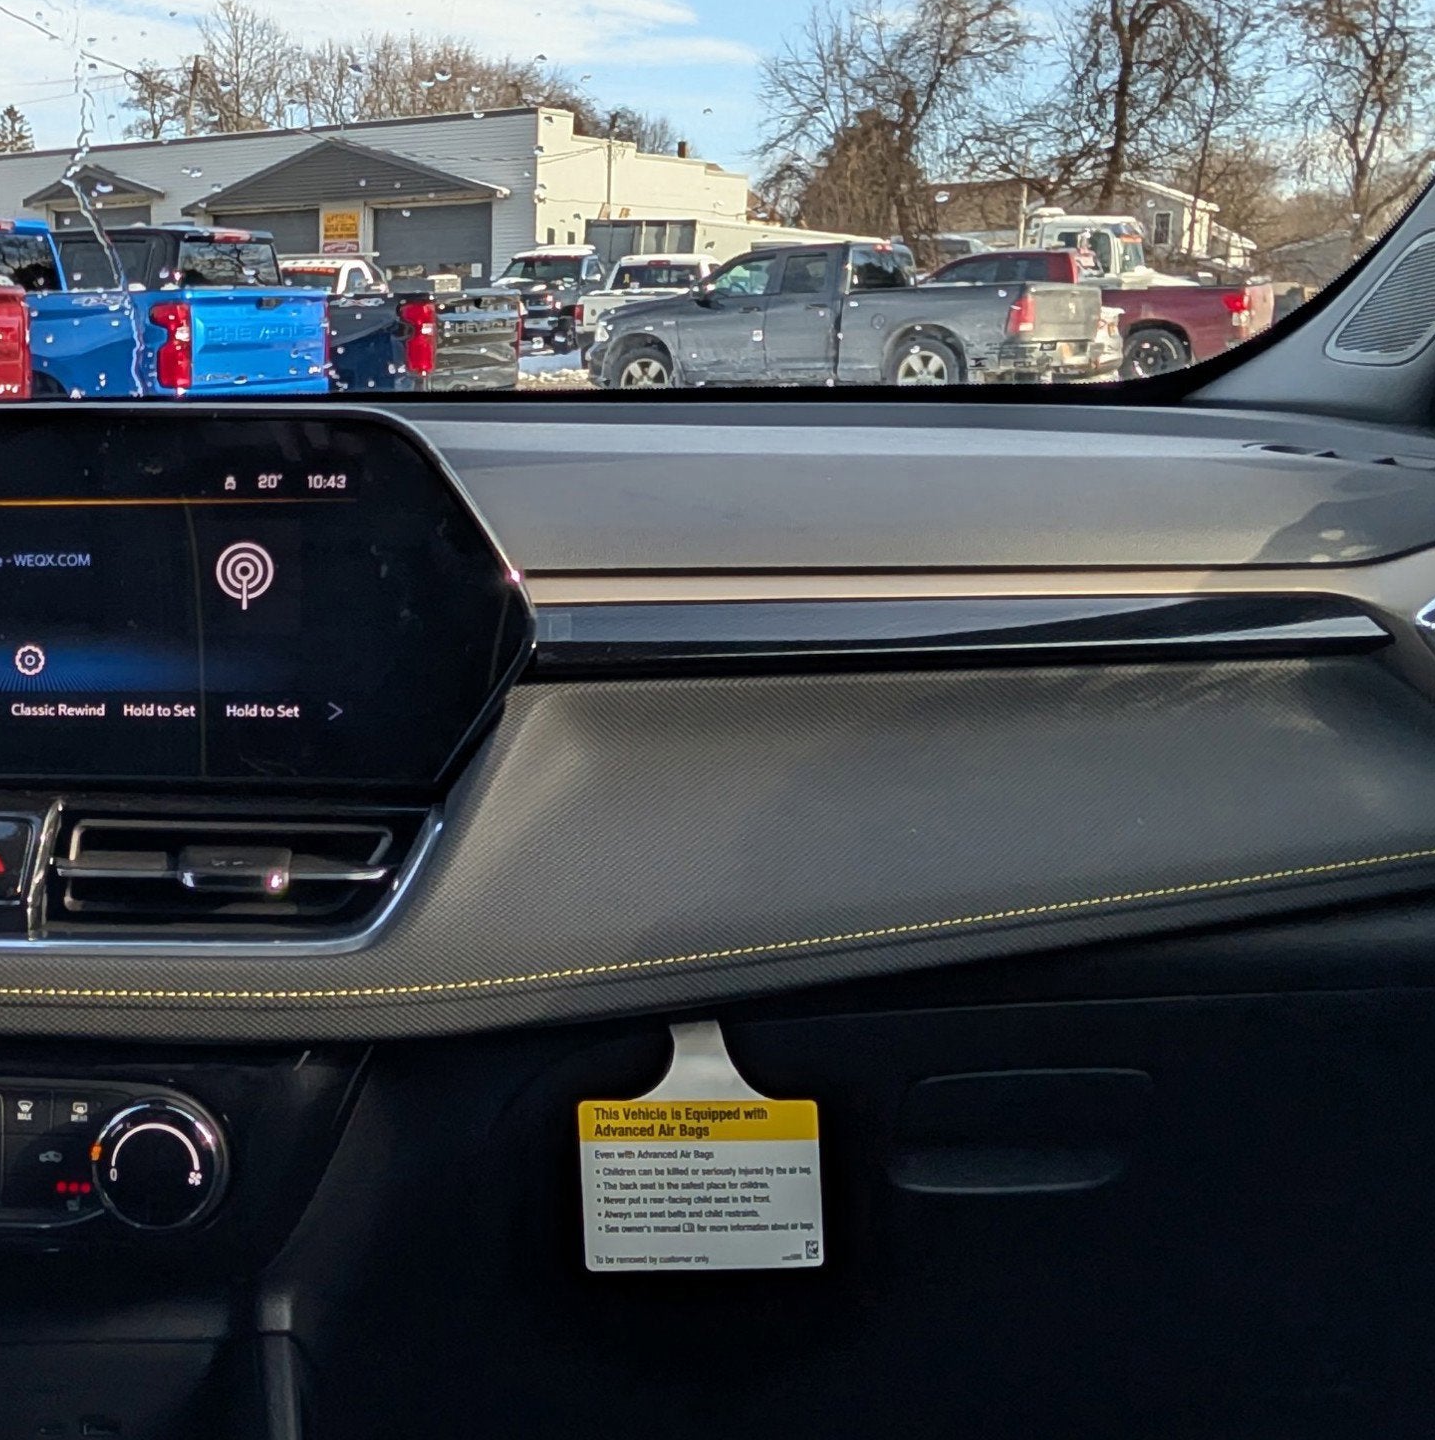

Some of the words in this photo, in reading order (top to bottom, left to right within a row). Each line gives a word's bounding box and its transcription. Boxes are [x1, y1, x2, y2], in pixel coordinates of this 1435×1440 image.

[307, 474, 347, 489] 10:43
[15, 554, 91, 567] WEQX.COM
[10, 703, 55, 716] Classic
[57, 703, 106, 717] Rewind
[123, 704, 155, 717] Hold
[157, 705, 171, 717] to
[173, 704, 196, 717] Set
[226, 704, 258, 717] Hold
[260, 705, 274, 717] to
[277, 704, 300, 718] Set
[594, 1108, 619, 1120] This
[623, 1107, 667, 1120] Vehicle
[671, 1107, 682, 1120] is
[685, 1107, 740, 1122] Equipped
[743, 1107, 768, 1120] with
[594, 1124, 655, 1137] Advanced
[658, 1124, 676, 1137] Air
[679, 1124, 710, 1139] Bags
[595, 1150, 615, 1159] Even
[617, 1150, 635, 1159] with
[638, 1150, 677, 1159] Advanced
[680, 1150, 692, 1159] Air
[694, 1150, 714, 1160] Bags
[110, 1168, 118, 1181] 0
[595, 1256, 603, 1264] To
[605, 1256, 614, 1264] be
[617, 1256, 647, 1264] removed
[649, 1256, 657, 1265] by
[659, 1256, 692, 1264] customer
[694, 1255, 710, 1264] only
